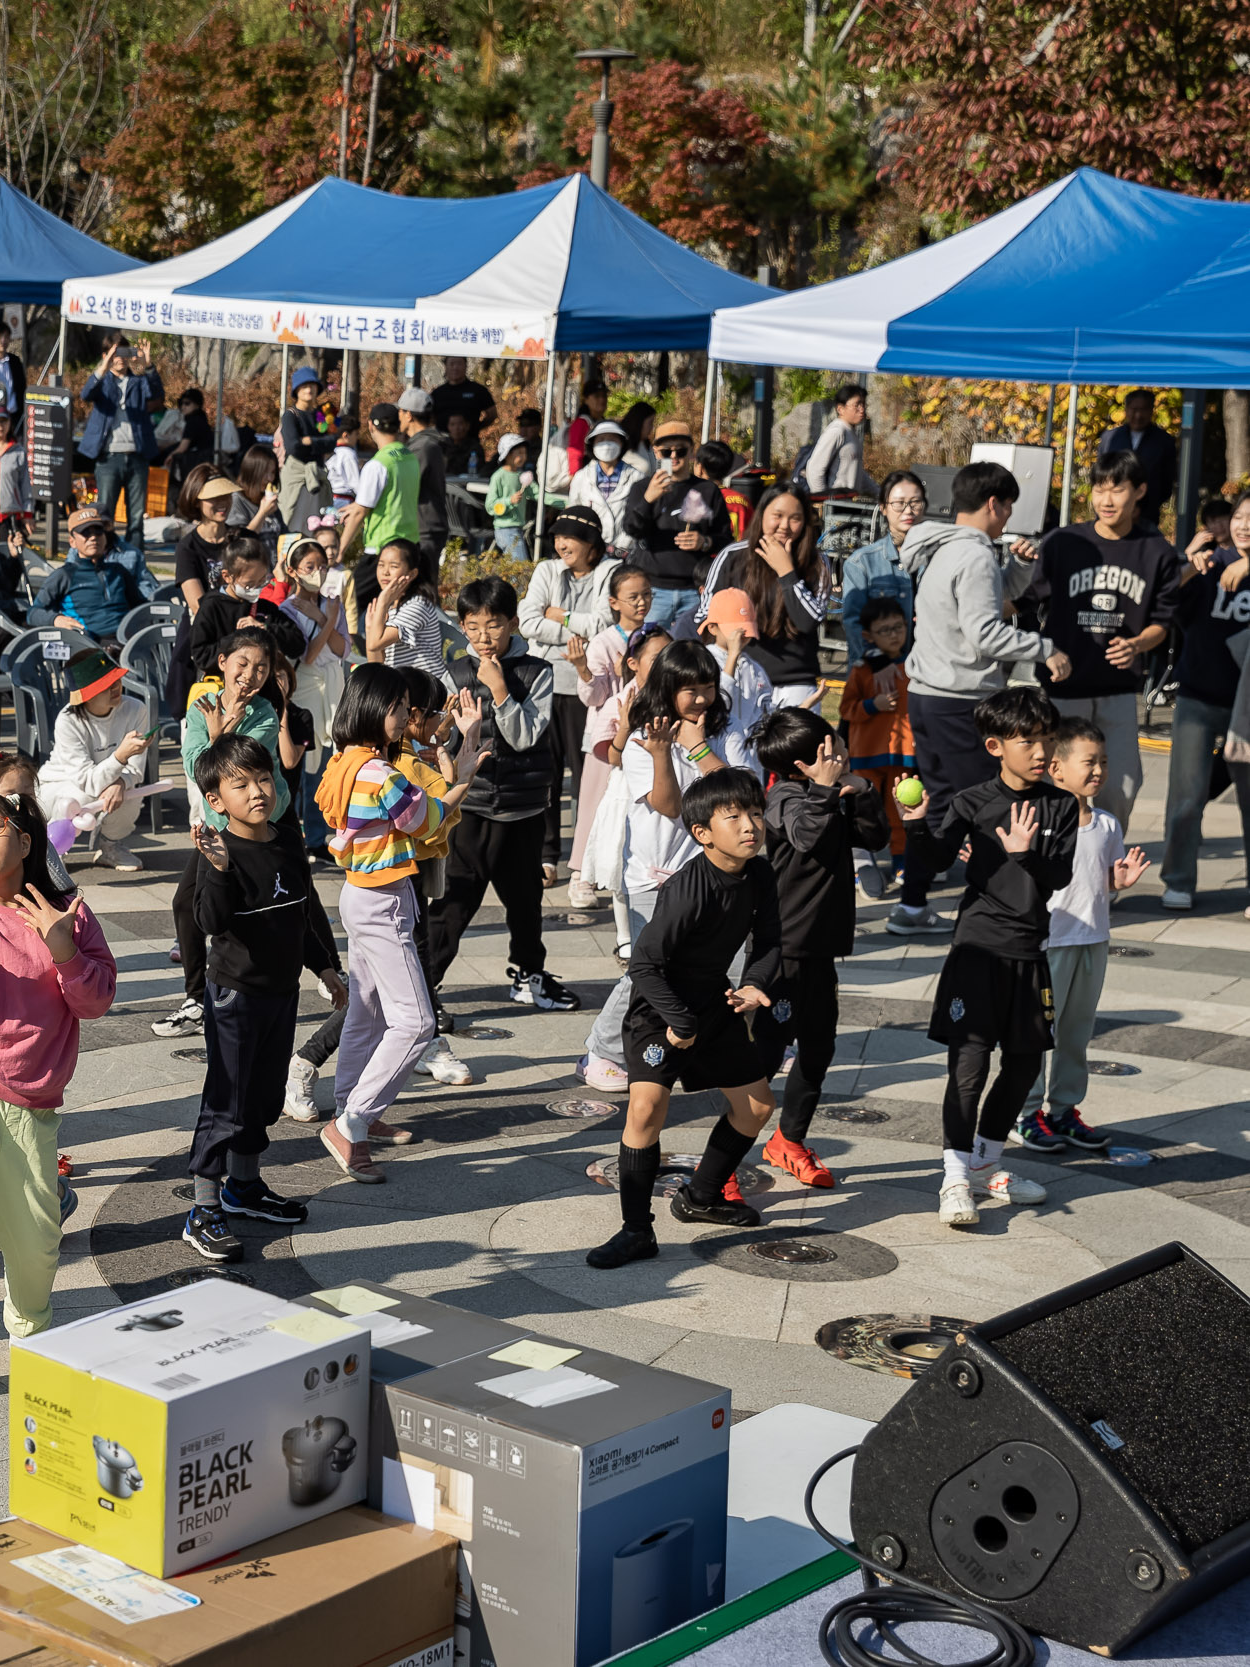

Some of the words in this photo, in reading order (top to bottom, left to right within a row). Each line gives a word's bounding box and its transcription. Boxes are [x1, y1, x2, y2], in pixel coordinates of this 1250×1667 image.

[86, 296, 173, 326] 오석한방병원
[318, 315, 425, 345] 재난구조협회
[1069, 564, 1146, 605] OREGON
[156, 1349, 200, 1367] BLACK
[200, 1336, 238, 1351] PEARL
[24, 1392, 47, 1408] BLACK
[50, 1402, 72, 1418] PEARL
[179, 1440, 253, 1488] BLACK
[588, 1463, 609, 1479] 스마트
[612, 1450, 644, 1470] 공기청정기
[645, 1448, 650, 1456] 4
[651, 1436, 679, 1454] Compact
[589, 1448, 621, 1468] xiaomi
[179, 1468, 252, 1515] PEARL
[177, 1502, 232, 1535] TRENDY
[208, 1568, 244, 1584] magic
[244, 1559, 270, 1571] SK
